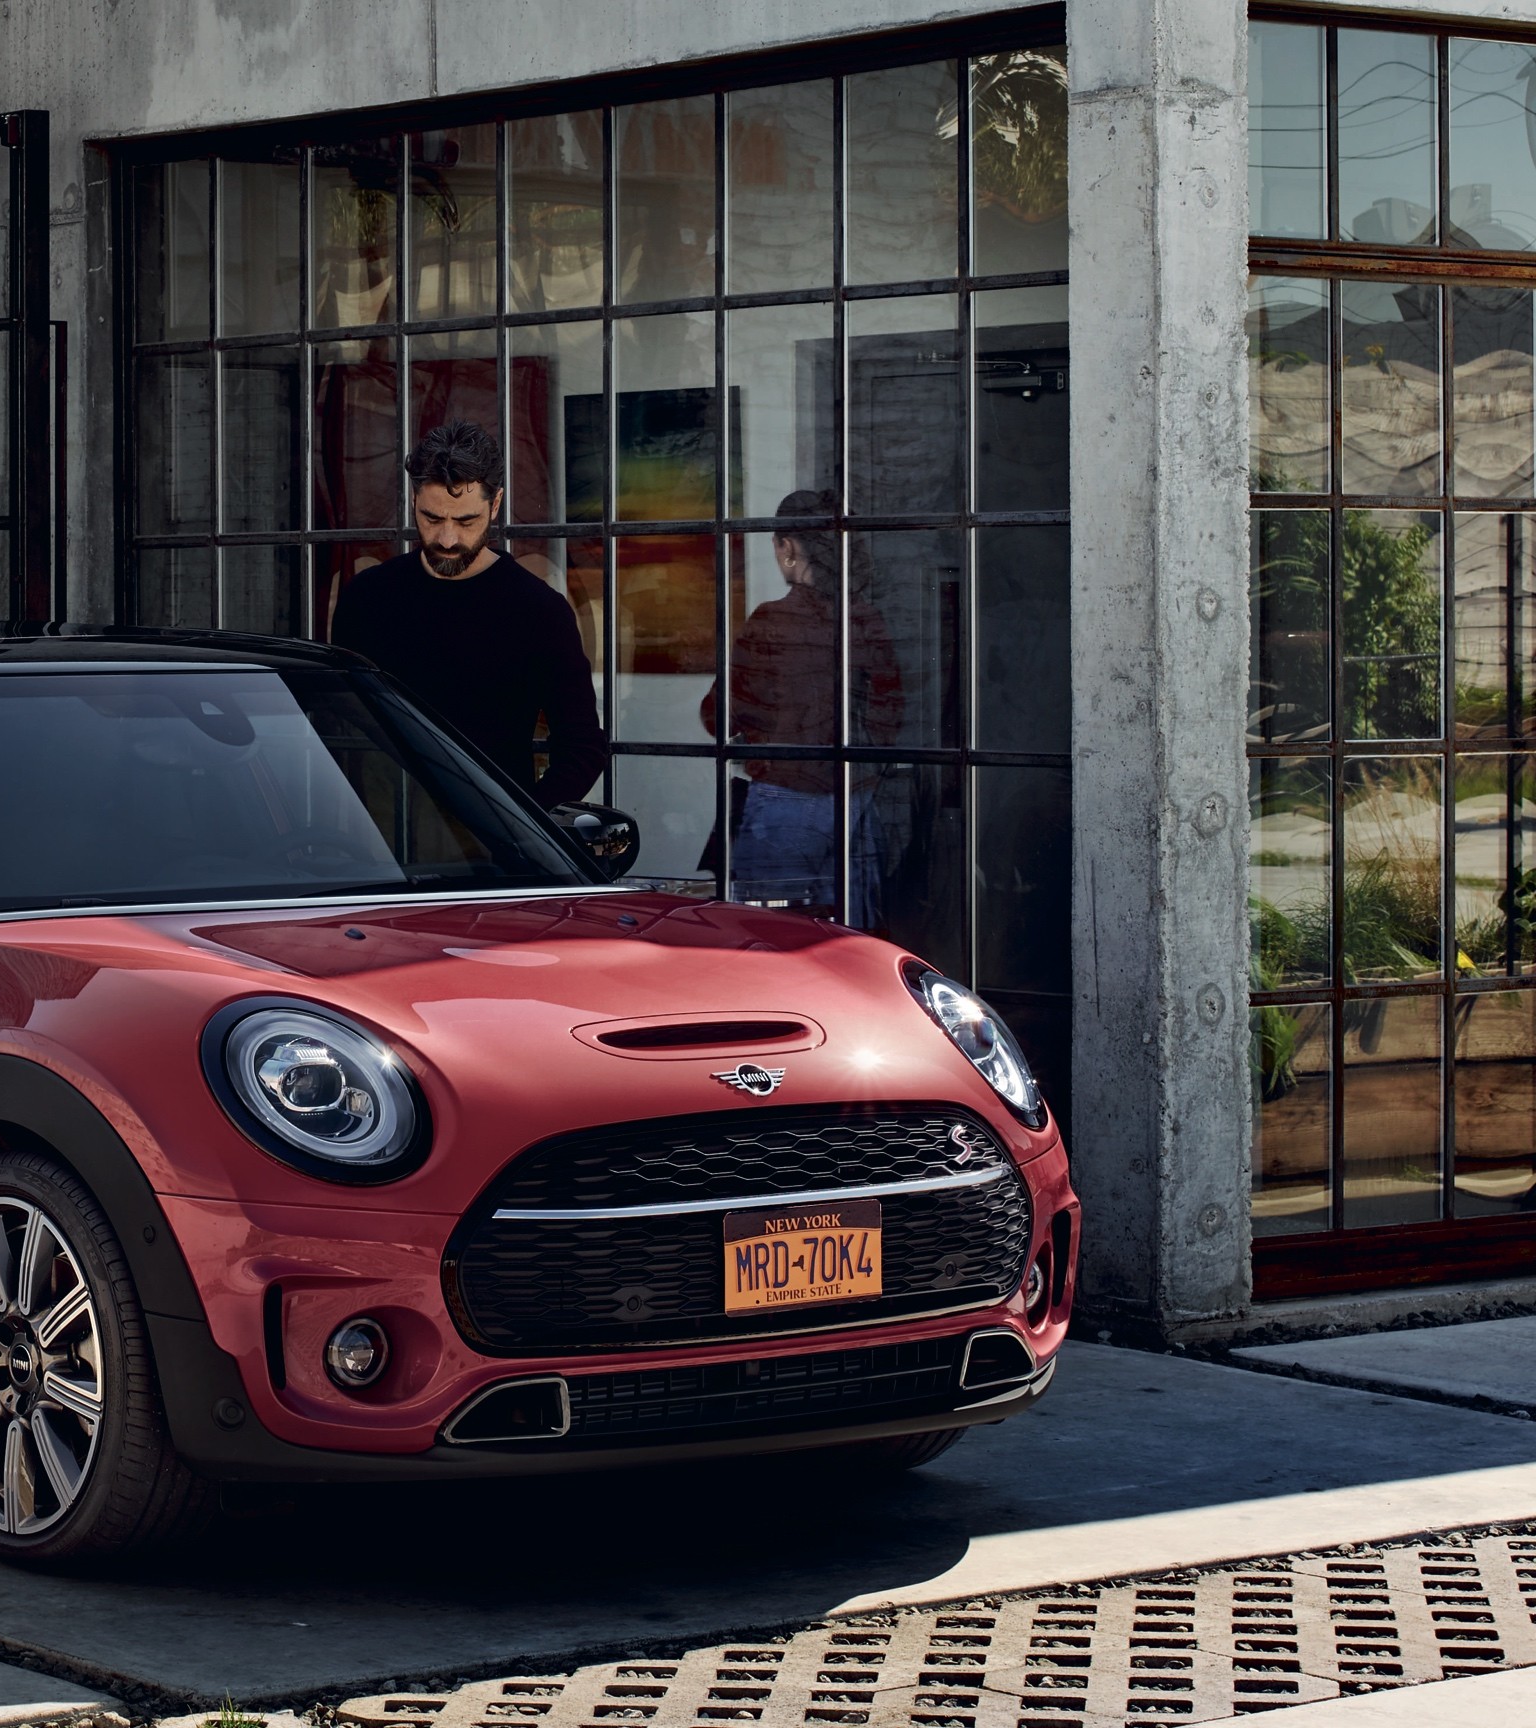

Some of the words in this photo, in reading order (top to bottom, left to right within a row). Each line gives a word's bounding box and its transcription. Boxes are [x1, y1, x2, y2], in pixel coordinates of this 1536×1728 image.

[741, 1072, 769, 1083] MINI
[951, 1124, 972, 1165] S
[765, 1217, 800, 1234] NEW
[803, 1213, 841, 1229] YORK
[766, 1289, 807, 1303] EMPIRE
[809, 1283, 842, 1297] STATE
[12, 1358, 29, 1371] MINI
